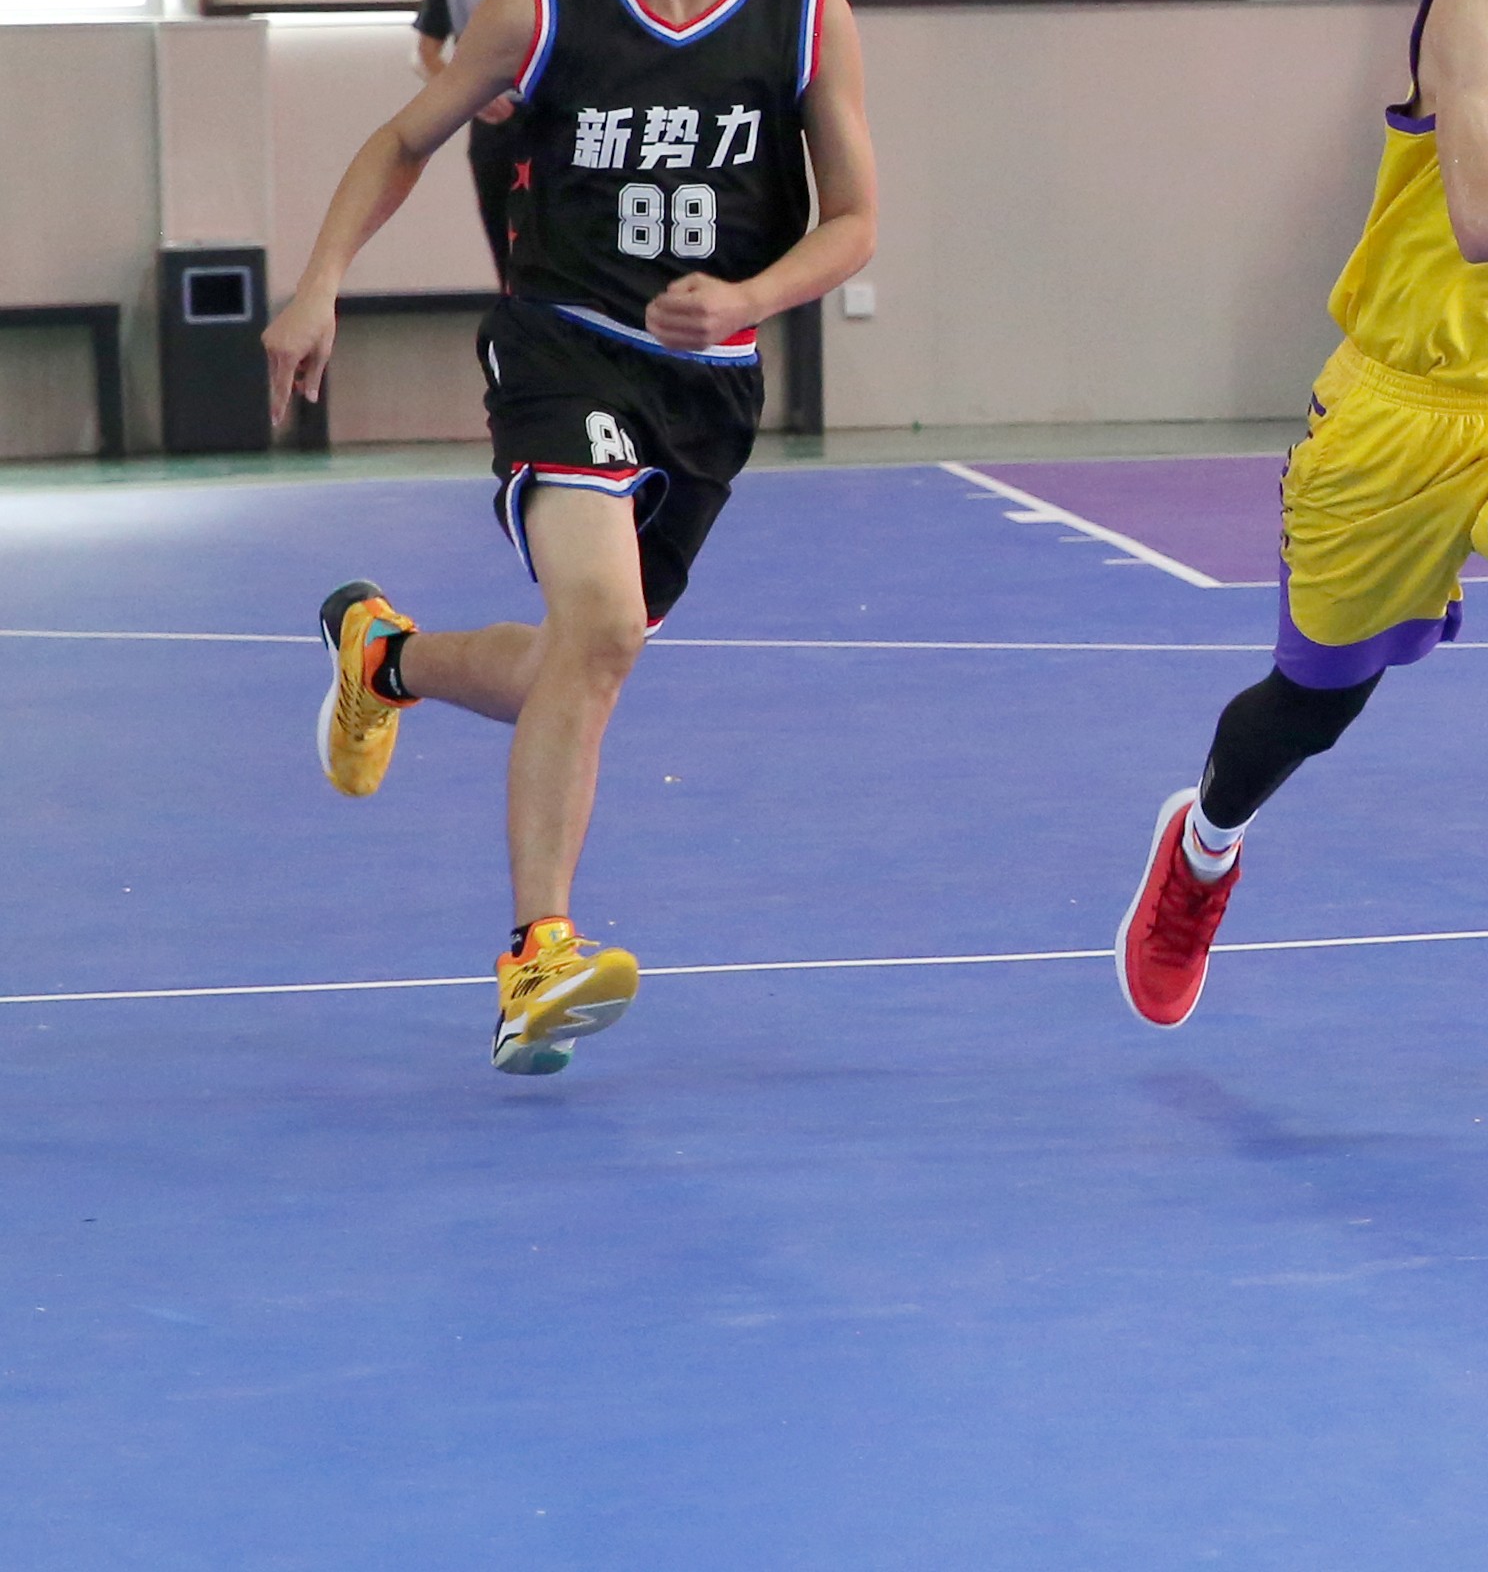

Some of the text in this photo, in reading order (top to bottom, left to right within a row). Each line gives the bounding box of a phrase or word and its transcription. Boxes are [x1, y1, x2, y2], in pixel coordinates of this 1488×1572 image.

[571, 103, 762, 170] 新势力
[618, 182, 717, 260] 88
